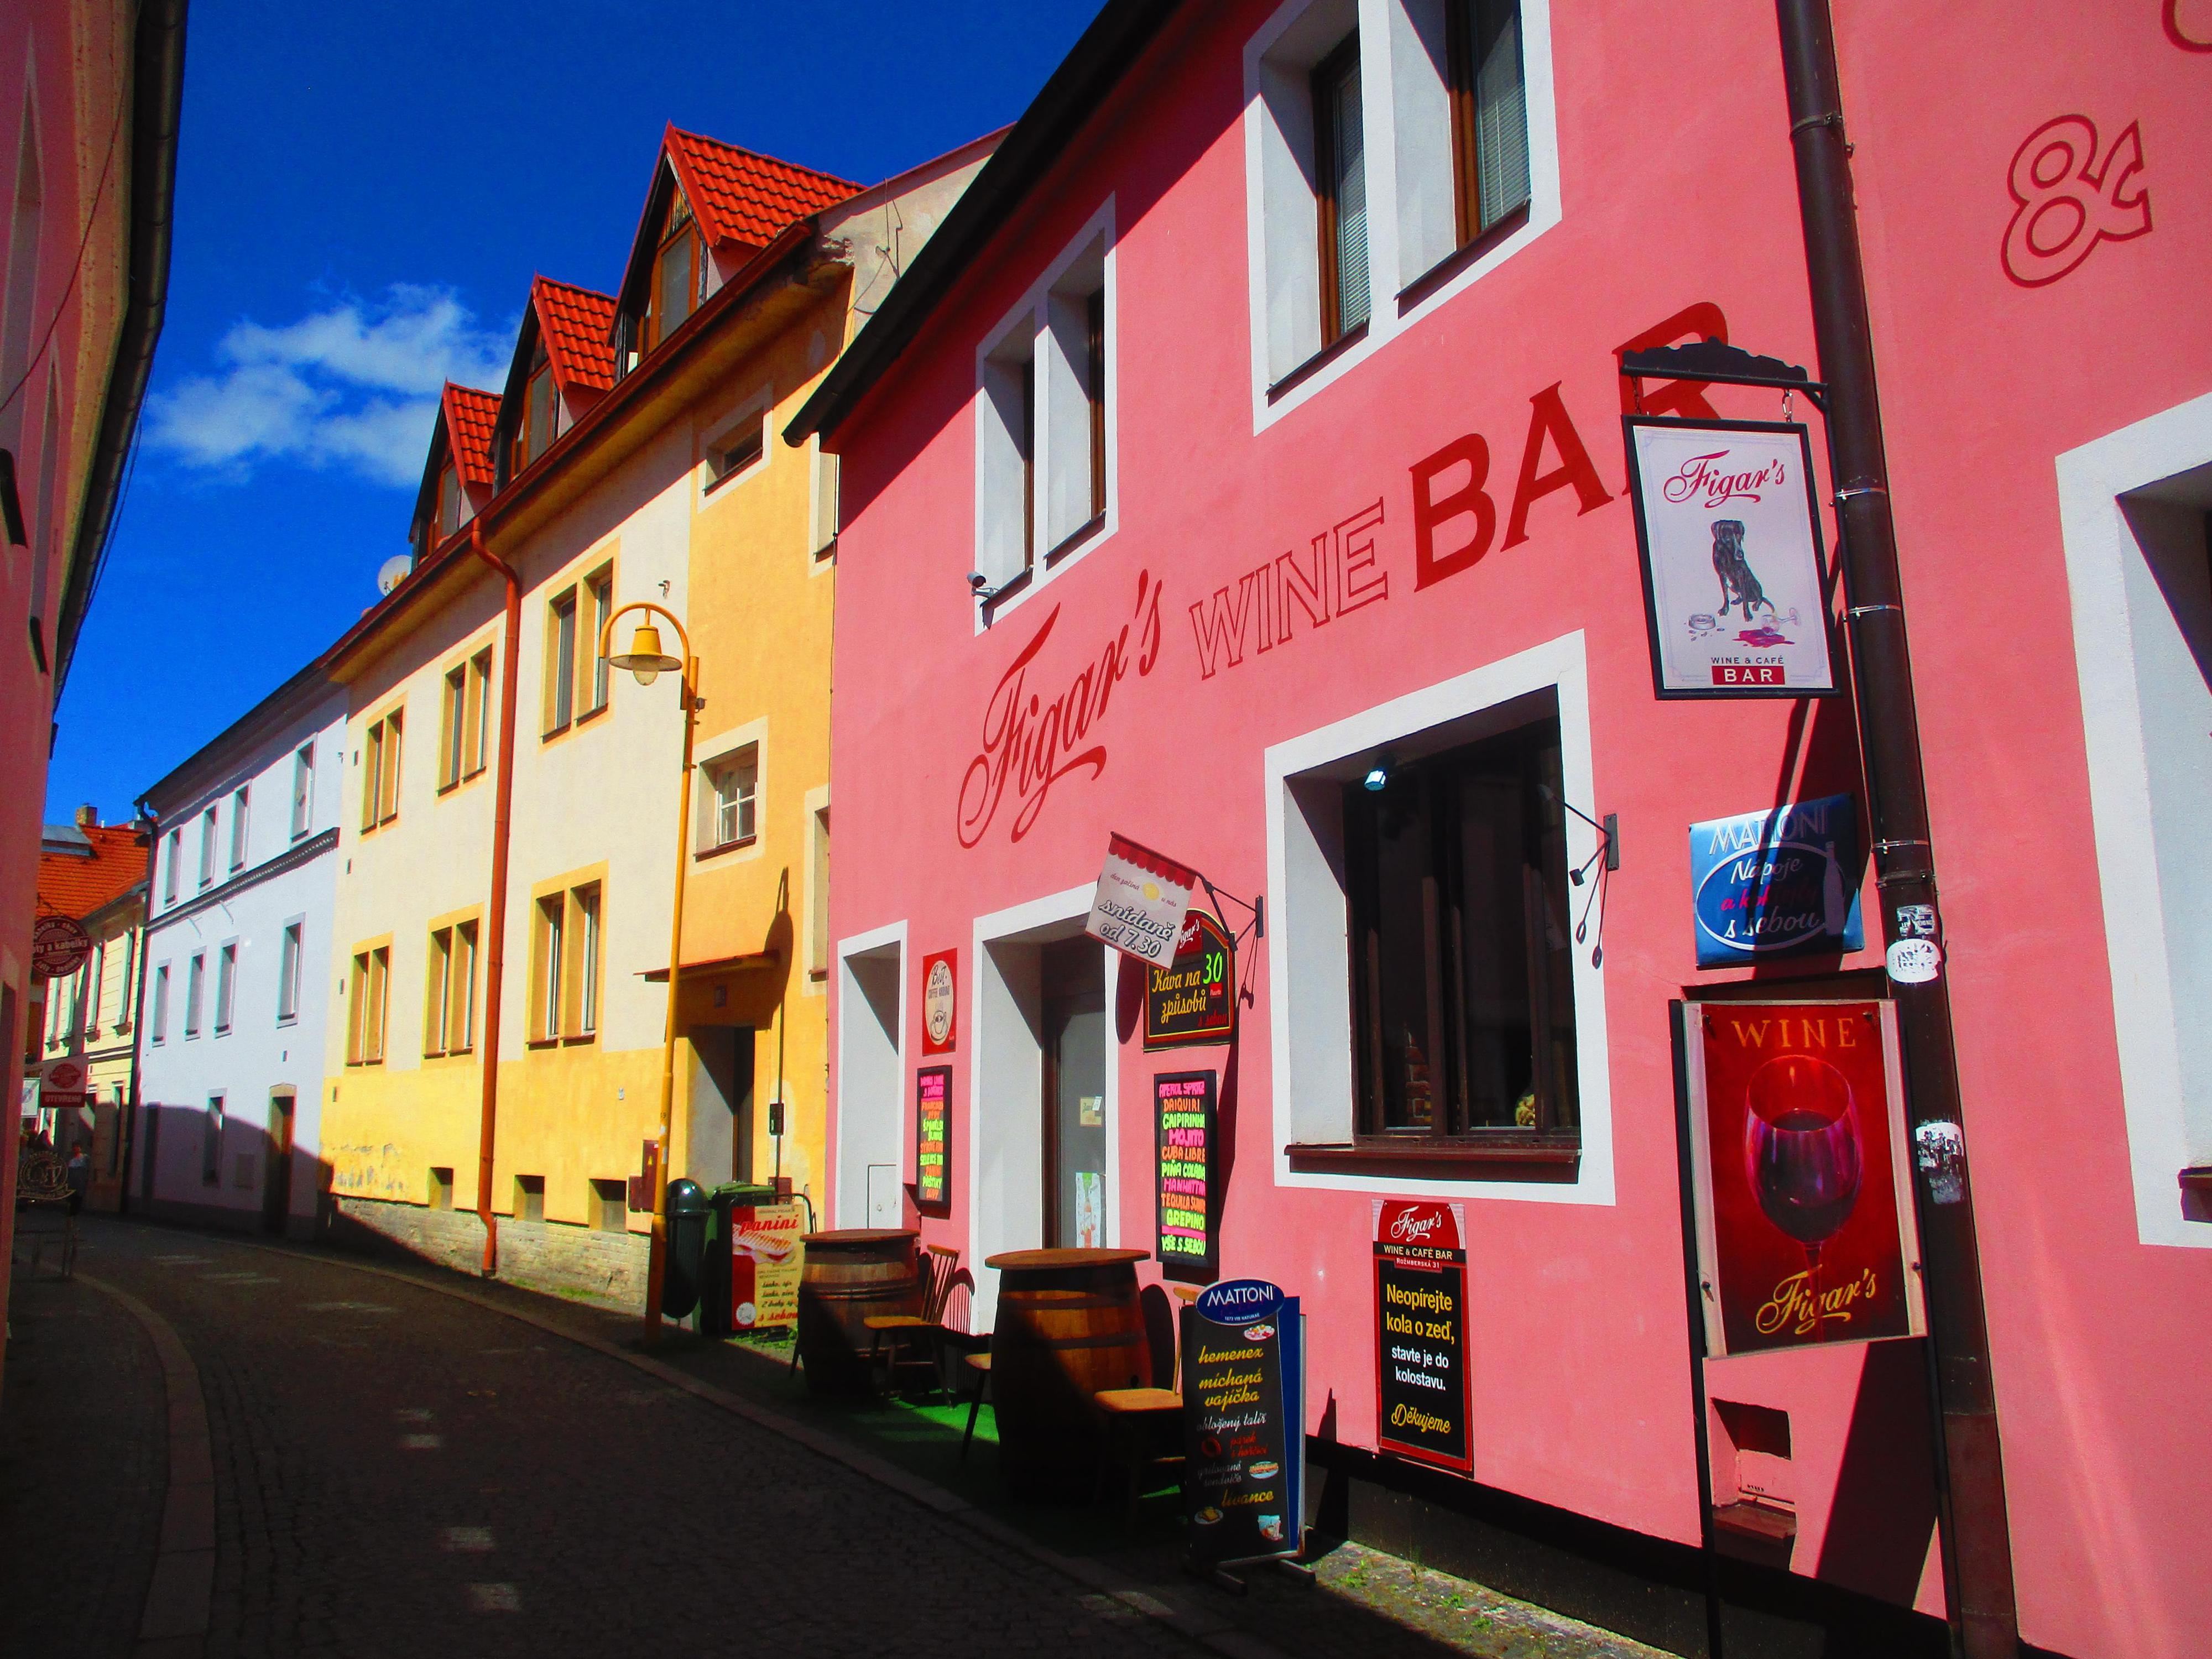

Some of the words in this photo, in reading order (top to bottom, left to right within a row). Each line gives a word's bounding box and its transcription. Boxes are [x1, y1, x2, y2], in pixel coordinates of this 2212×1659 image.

[2001, 113, 2153, 288] &
[1663, 450, 1785, 508] Figar's
[957, 568, 1162, 849] Figar's
[1189, 496, 1388, 680] WINE
[1755, 655, 1784, 664] CAFÉ
[1724, 668, 1773, 683] BAR
[1709, 804, 1829, 855] MATTONI
[1110, 873, 1121, 882] den
[1730, 858, 1802, 885] Nápoje
[1098, 899, 1176, 942] snídaně
[1178, 919, 1201, 949] igar's
[1724, 920, 1736, 938] s
[1743, 906, 1820, 936] sebou
[1099, 922, 1125, 942] od
[1124, 928, 1161, 958] 7.30
[1152, 969, 1182, 993] Káva
[1185, 970, 1201, 988] na
[1203, 952, 1223, 984] 30
[1161, 989, 1206, 1024] způsobů
[1731, 1018, 1856, 1048] WINE
[1164, 1098, 1200, 1112] DAIQUIRI
[1169, 1128, 1204, 1147] MOJITO
[1162, 1145, 1183, 1160] CUBA
[1185, 1147, 1206, 1162] LIBRE
[1161, 1193, 1190, 1210] TEQUILA
[739, 1214, 799, 1237] panini
[1391, 1206, 1442, 1242] Figar's
[1162, 1234, 1176, 1251] VŠE
[1177, 1237, 1182, 1251] S
[1384, 1245, 1404, 1255] WINE
[1412, 1247, 1434, 1258] CAFÉ
[1436, 1250, 1453, 1260] BAR
[1207, 1285, 1273, 1307] MATTONI
[1386, 1284, 1452, 1314] Neopírejte
[1756, 1264, 1876, 1335] Figar's
[1386, 1312, 1412, 1335] kola
[1415, 1321, 1423, 1335] o
[1426, 1321, 1455, 1345] zeď,
[1198, 1345, 1264, 1364] hemenex
[1392, 1345, 1421, 1363] stavte
[1423, 1349, 1433, 1368] je
[1436, 1352, 1449, 1369] do
[1199, 1368, 1262, 1390] míchaná
[1396, 1366, 1446, 1391] kolostavu.
[1204, 1385, 1260, 1412] vajíčka
[1244, 1411, 1267, 1426] talíř
[1391, 1404, 1452, 1434] Děkujeme
